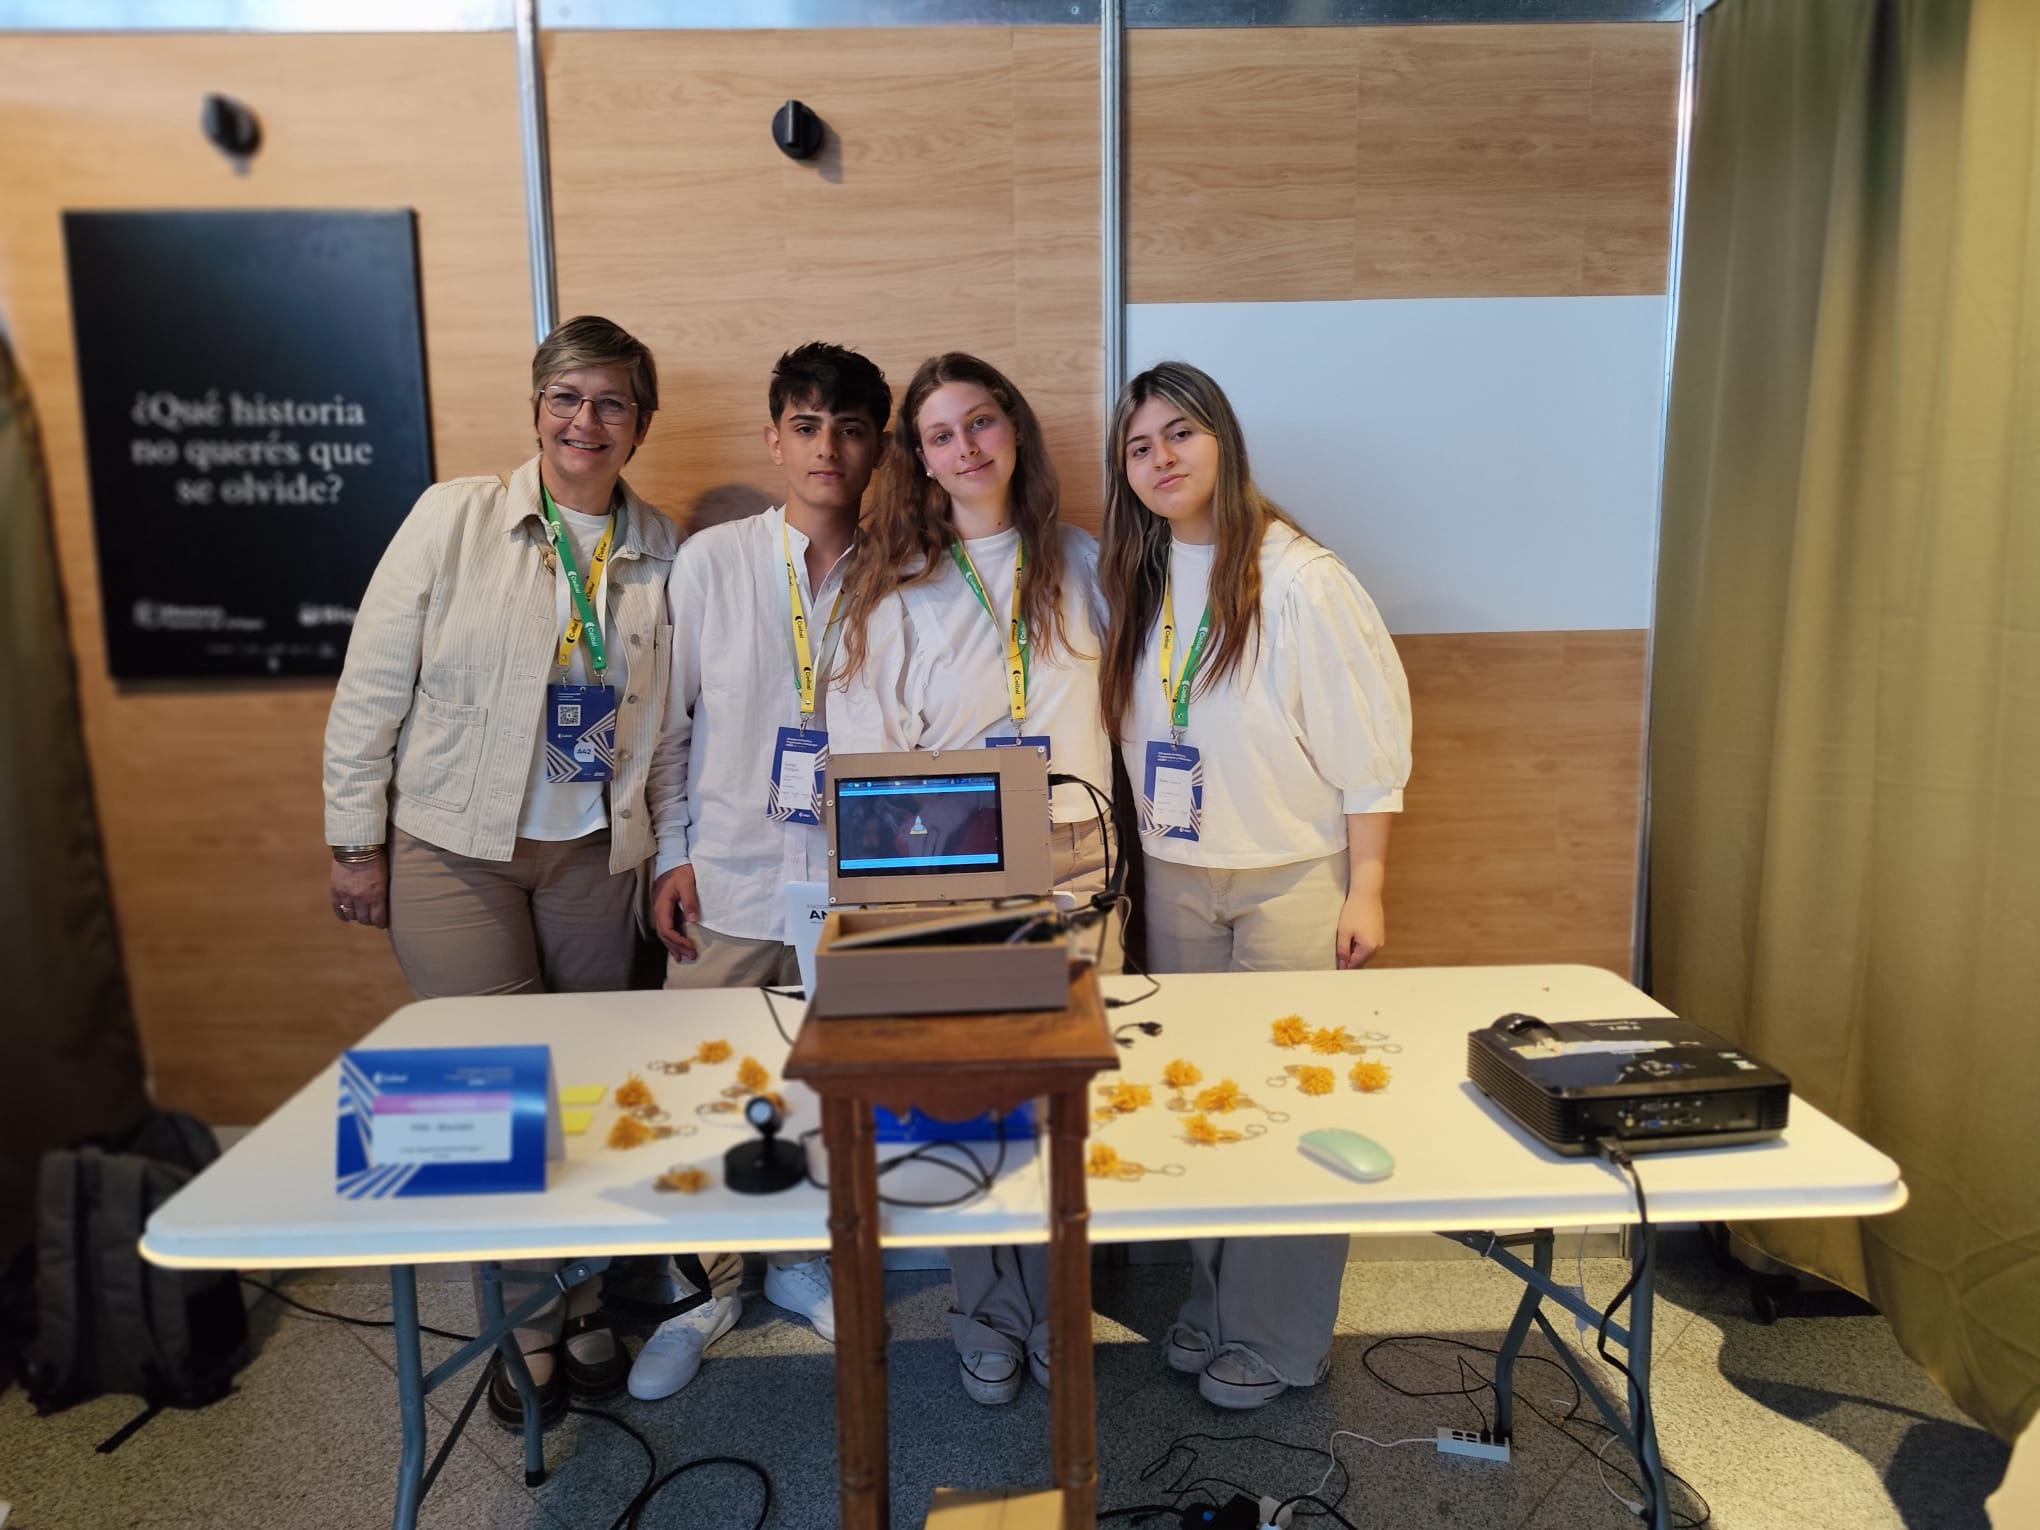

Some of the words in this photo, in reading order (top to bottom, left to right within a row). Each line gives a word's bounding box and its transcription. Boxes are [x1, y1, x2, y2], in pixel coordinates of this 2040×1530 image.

[131, 389, 223, 431] ¿Qué
[231, 393, 366, 426] historia
[131, 441, 179, 466] no
[184, 433, 300, 472] querés
[308, 441, 373, 470] que
[176, 478, 215, 505] se
[220, 474, 344, 505] olvide?
[570, 575, 582, 594] Ceibal
[587, 626, 598, 647] Ceibal
[797, 620, 805, 639] Ceibal
[1180, 686, 1188, 704] Ceibal
